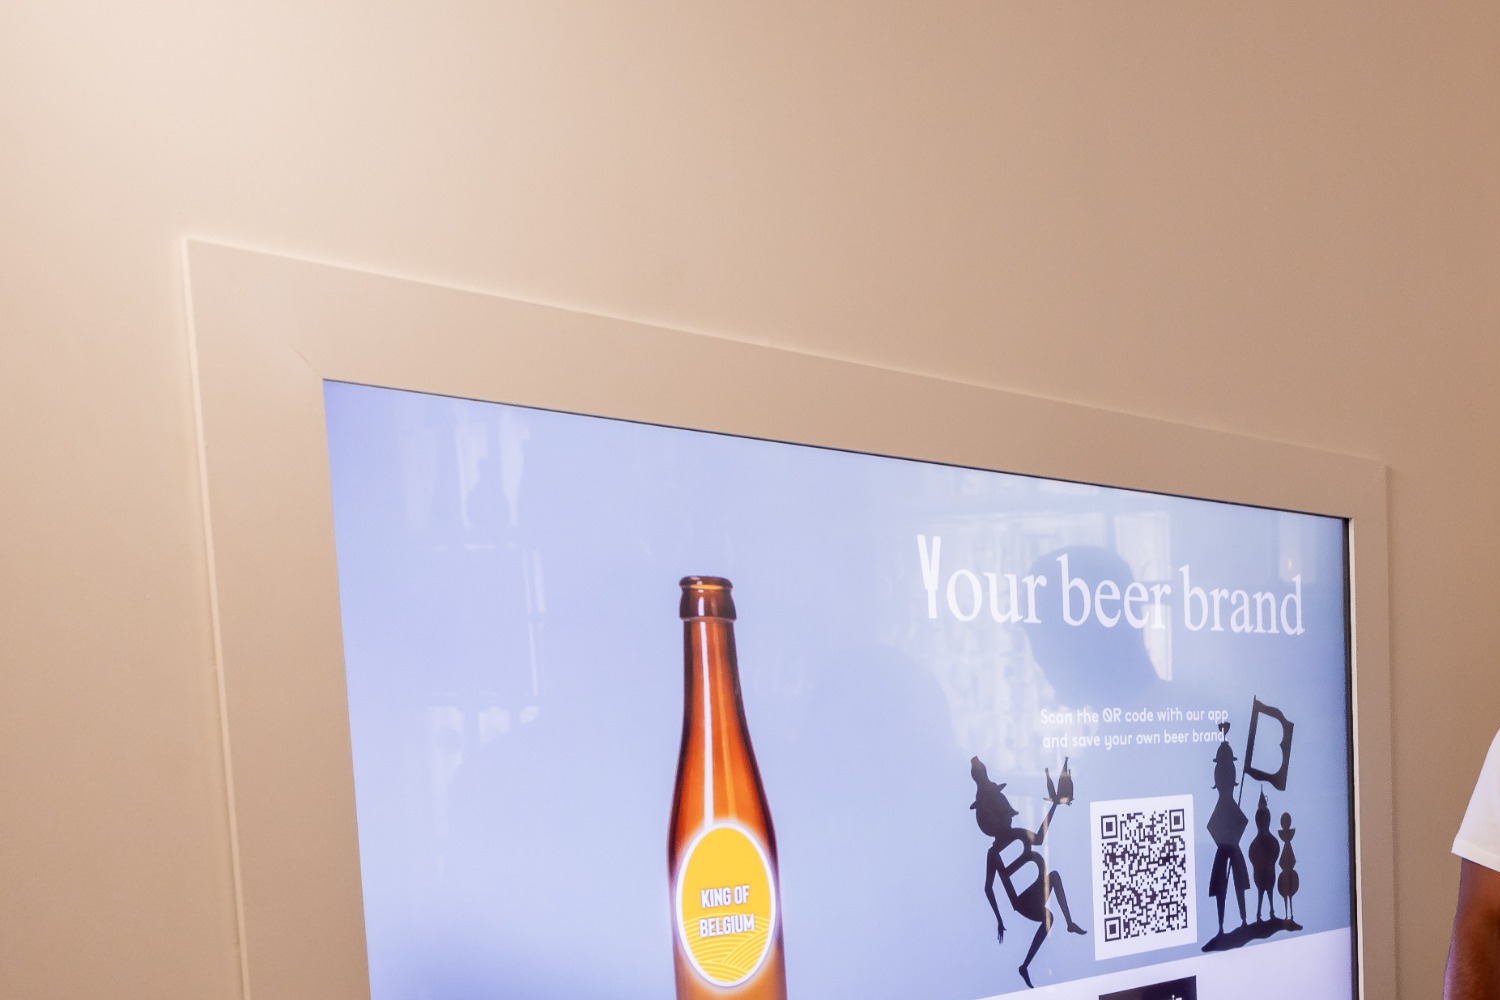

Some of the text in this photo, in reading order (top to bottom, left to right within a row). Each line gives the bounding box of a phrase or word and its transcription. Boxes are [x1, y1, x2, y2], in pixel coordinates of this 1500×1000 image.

[916, 534, 1305, 636] Your beer brand
[1040, 707, 1229, 724] Scan the QR code with our app
[1042, 727, 1228, 750] and save your own beer brand.
[700, 885, 750, 908] KING OF
[698, 914, 756, 939] BELGIUM
